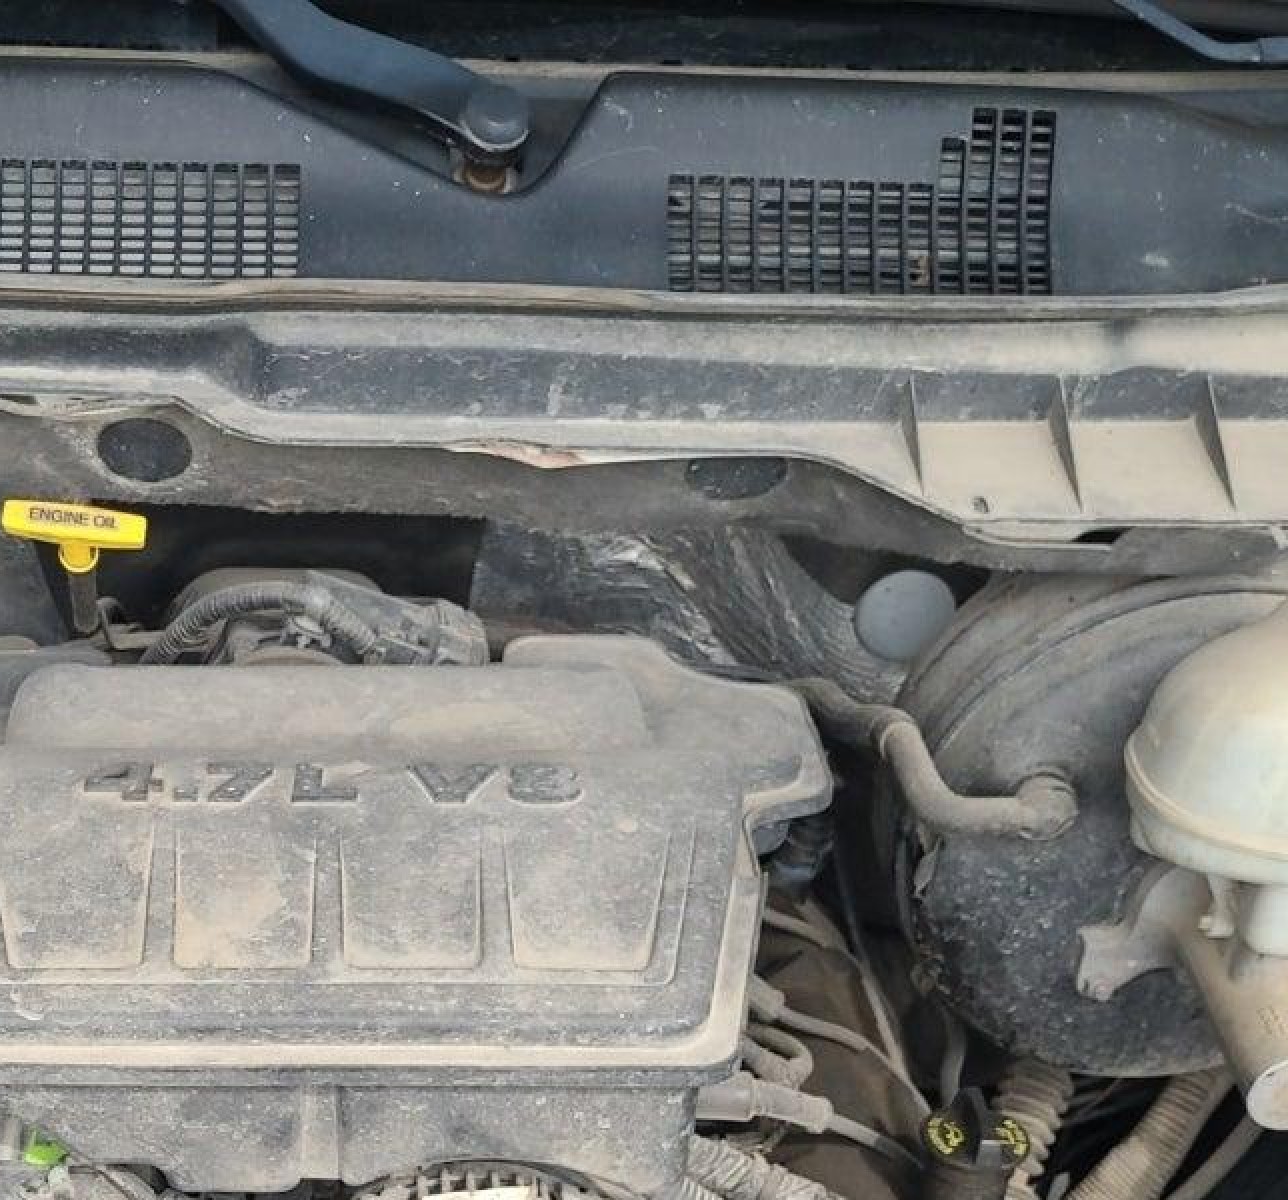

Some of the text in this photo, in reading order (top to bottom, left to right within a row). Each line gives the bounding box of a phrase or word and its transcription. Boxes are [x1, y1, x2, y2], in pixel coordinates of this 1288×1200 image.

[29, 507, 118, 529] ENGINE OIL
[84, 761, 582, 804] 4.7L V8
